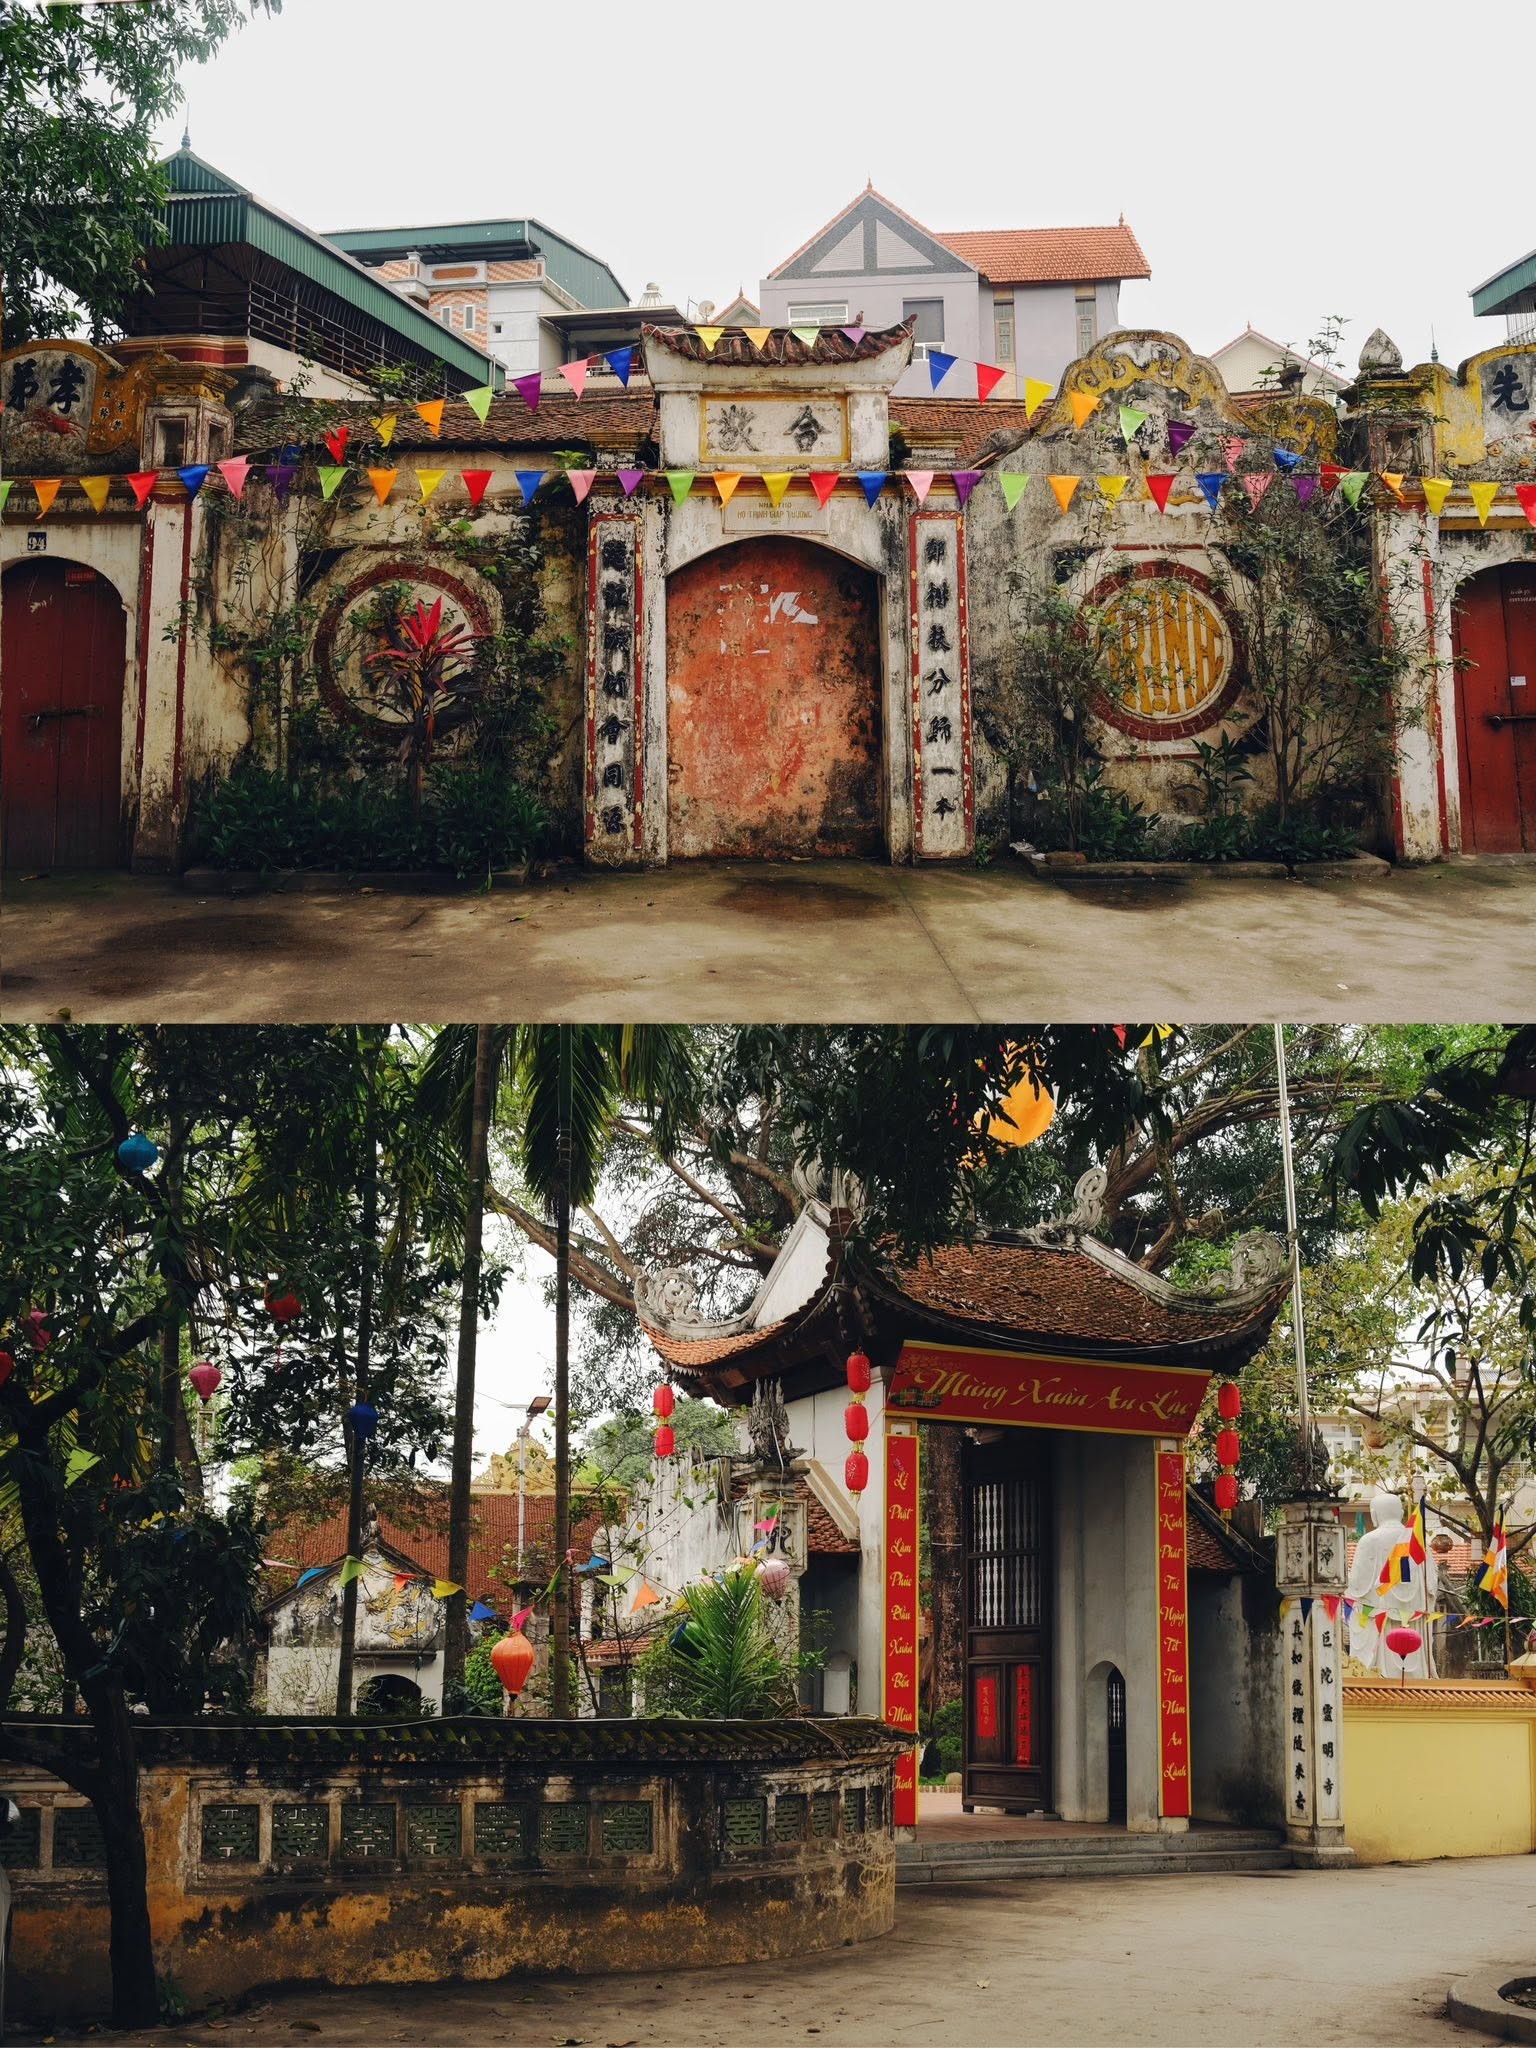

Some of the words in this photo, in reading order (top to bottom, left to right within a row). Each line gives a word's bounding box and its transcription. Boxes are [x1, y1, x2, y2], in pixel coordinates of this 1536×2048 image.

[1490, 364, 1530, 411] 先
[28, 536, 46, 550] 94
[1088, 1385, 1137, 1410] An
[1159, 1513, 1183, 1531] Kinh
[1167, 1731, 1182, 1747] An
